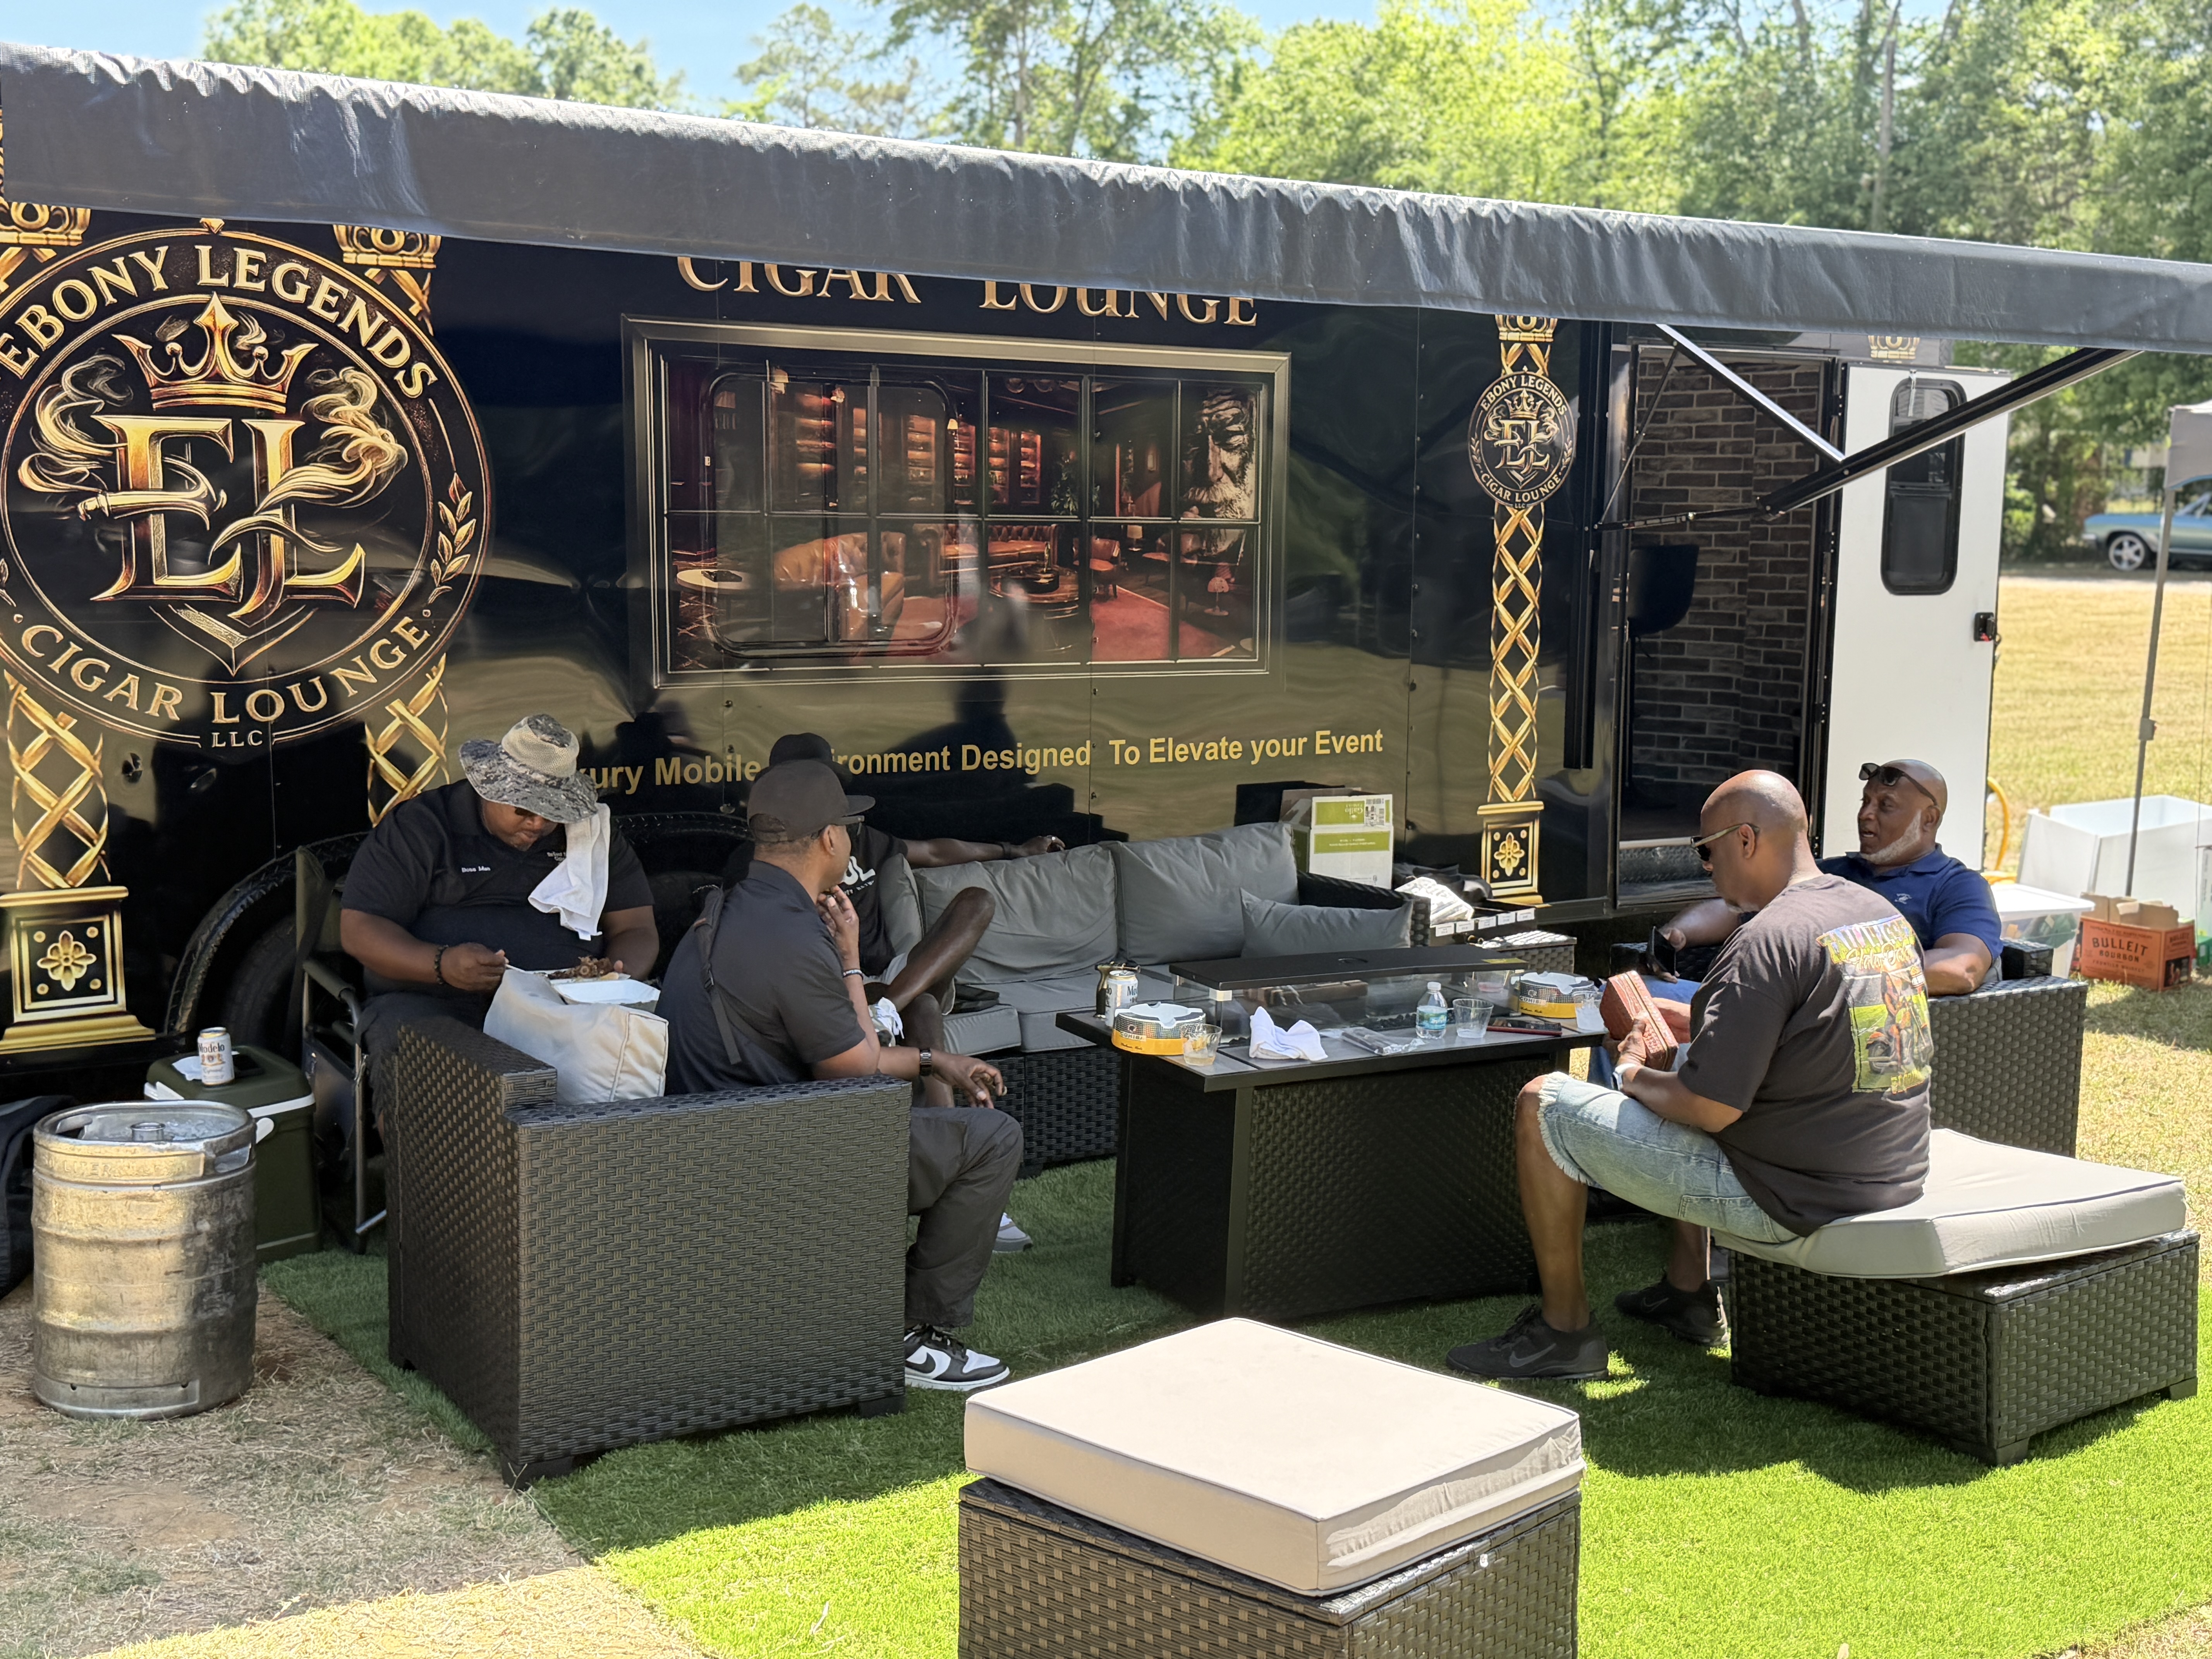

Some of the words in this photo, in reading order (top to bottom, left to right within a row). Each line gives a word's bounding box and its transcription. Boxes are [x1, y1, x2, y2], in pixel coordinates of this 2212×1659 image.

[0, 246, 169, 380] EBONY
[195, 244, 437, 398] LEGENDS
[1480, 375, 1517, 412] EBONY
[1521, 374, 1567, 416] LEGENDS
[1481, 473, 1511, 501] CIGAR
[1515, 476, 1561, 503] LOUNGE
[21, 623, 183, 721] CIGAR
[210, 616, 430, 725] LOUNGE
[211, 730, 263, 748] LLC
[580, 766, 644, 795] ury
[655, 754, 761, 785] Mobile
[831, 746, 950, 775] ronment
[962, 740, 1091, 775] Designed
[1109, 739, 1140, 765] To
[1149, 736, 1243, 763] Elevate
[1250, 737, 1308, 765] your
[1315, 728, 1383, 755] Event
[2092, 937, 2148, 956] BULLEIT
[2099, 950, 2140, 963] BOURBON
[198, 1042, 225, 1053] Modelo
